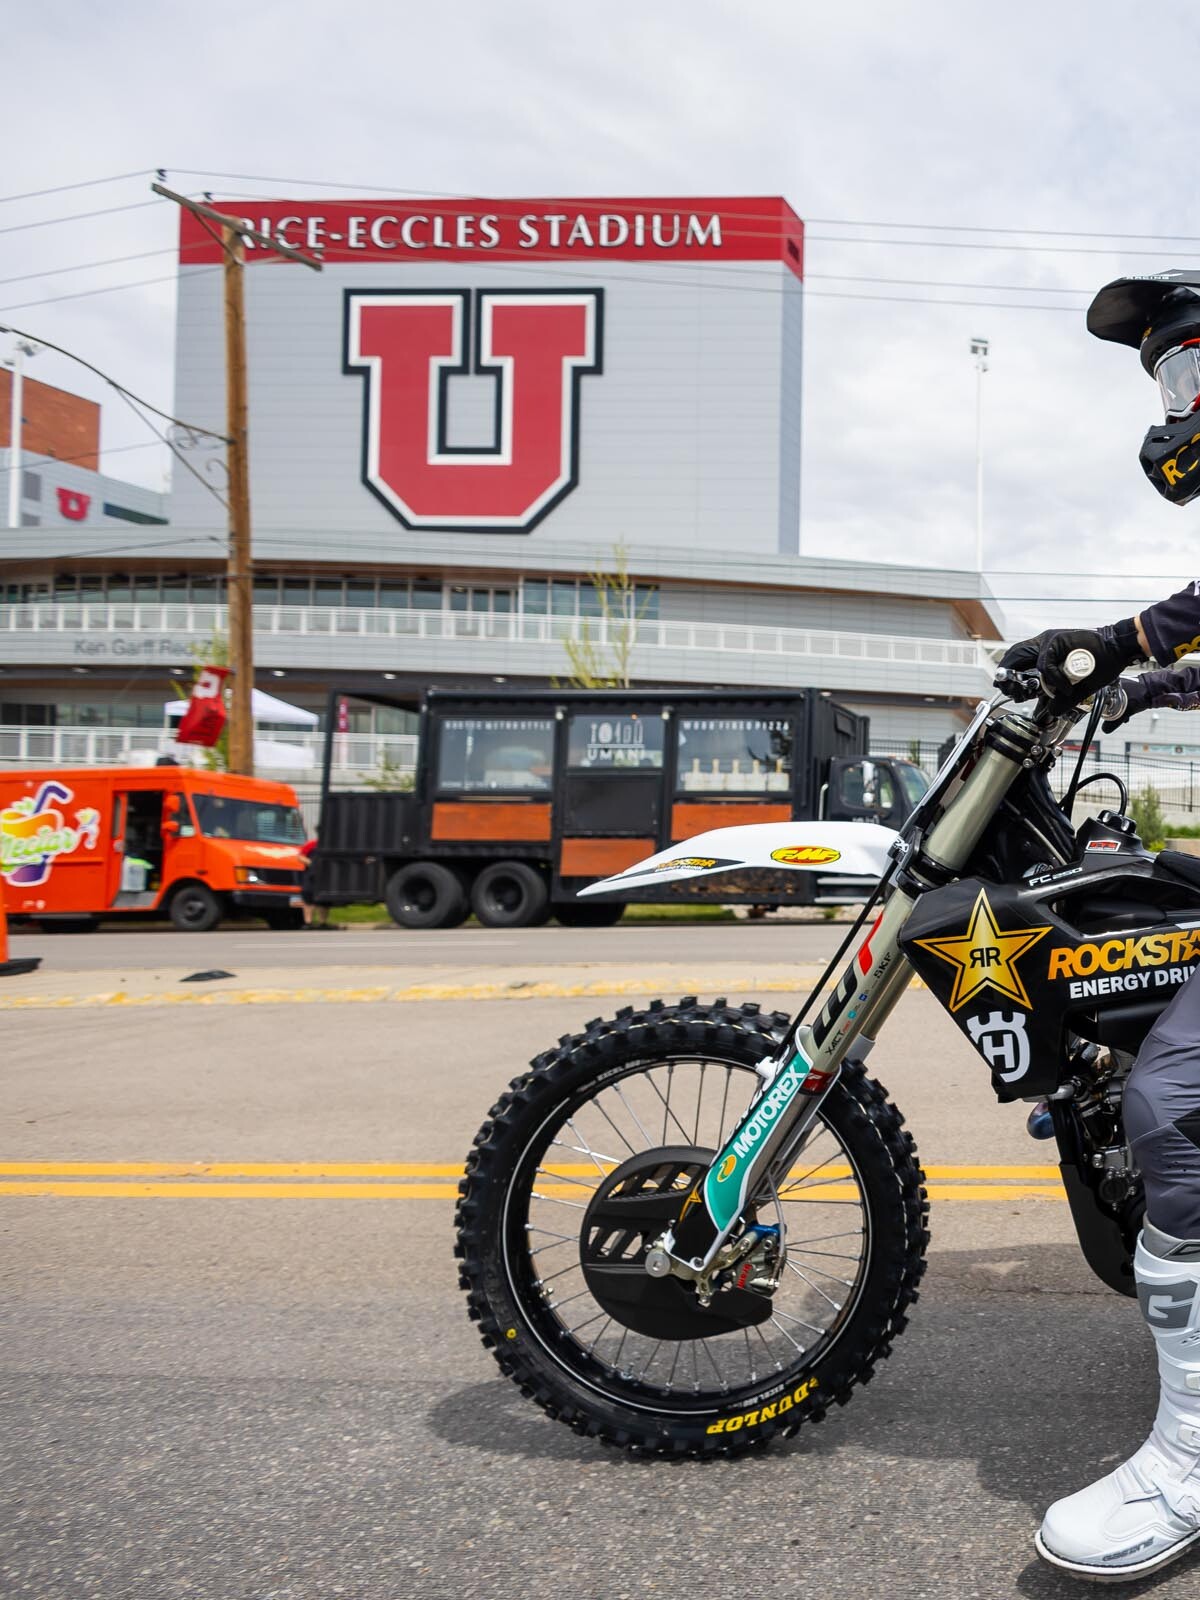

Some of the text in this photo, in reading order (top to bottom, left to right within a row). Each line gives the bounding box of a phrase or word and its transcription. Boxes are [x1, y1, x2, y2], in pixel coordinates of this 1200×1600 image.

[518, 213, 722, 249] STADIUM
[342, 287, 604, 534] U
[74, 639, 107, 654] Ken
[771, 847, 840, 864] FMF
[1028, 874, 1053, 887] FC
[1069, 971, 1150, 999] ENERGY
[732, 1063, 806, 1159] MOTOREX
[706, 1382, 810, 1435] DUNLOP
